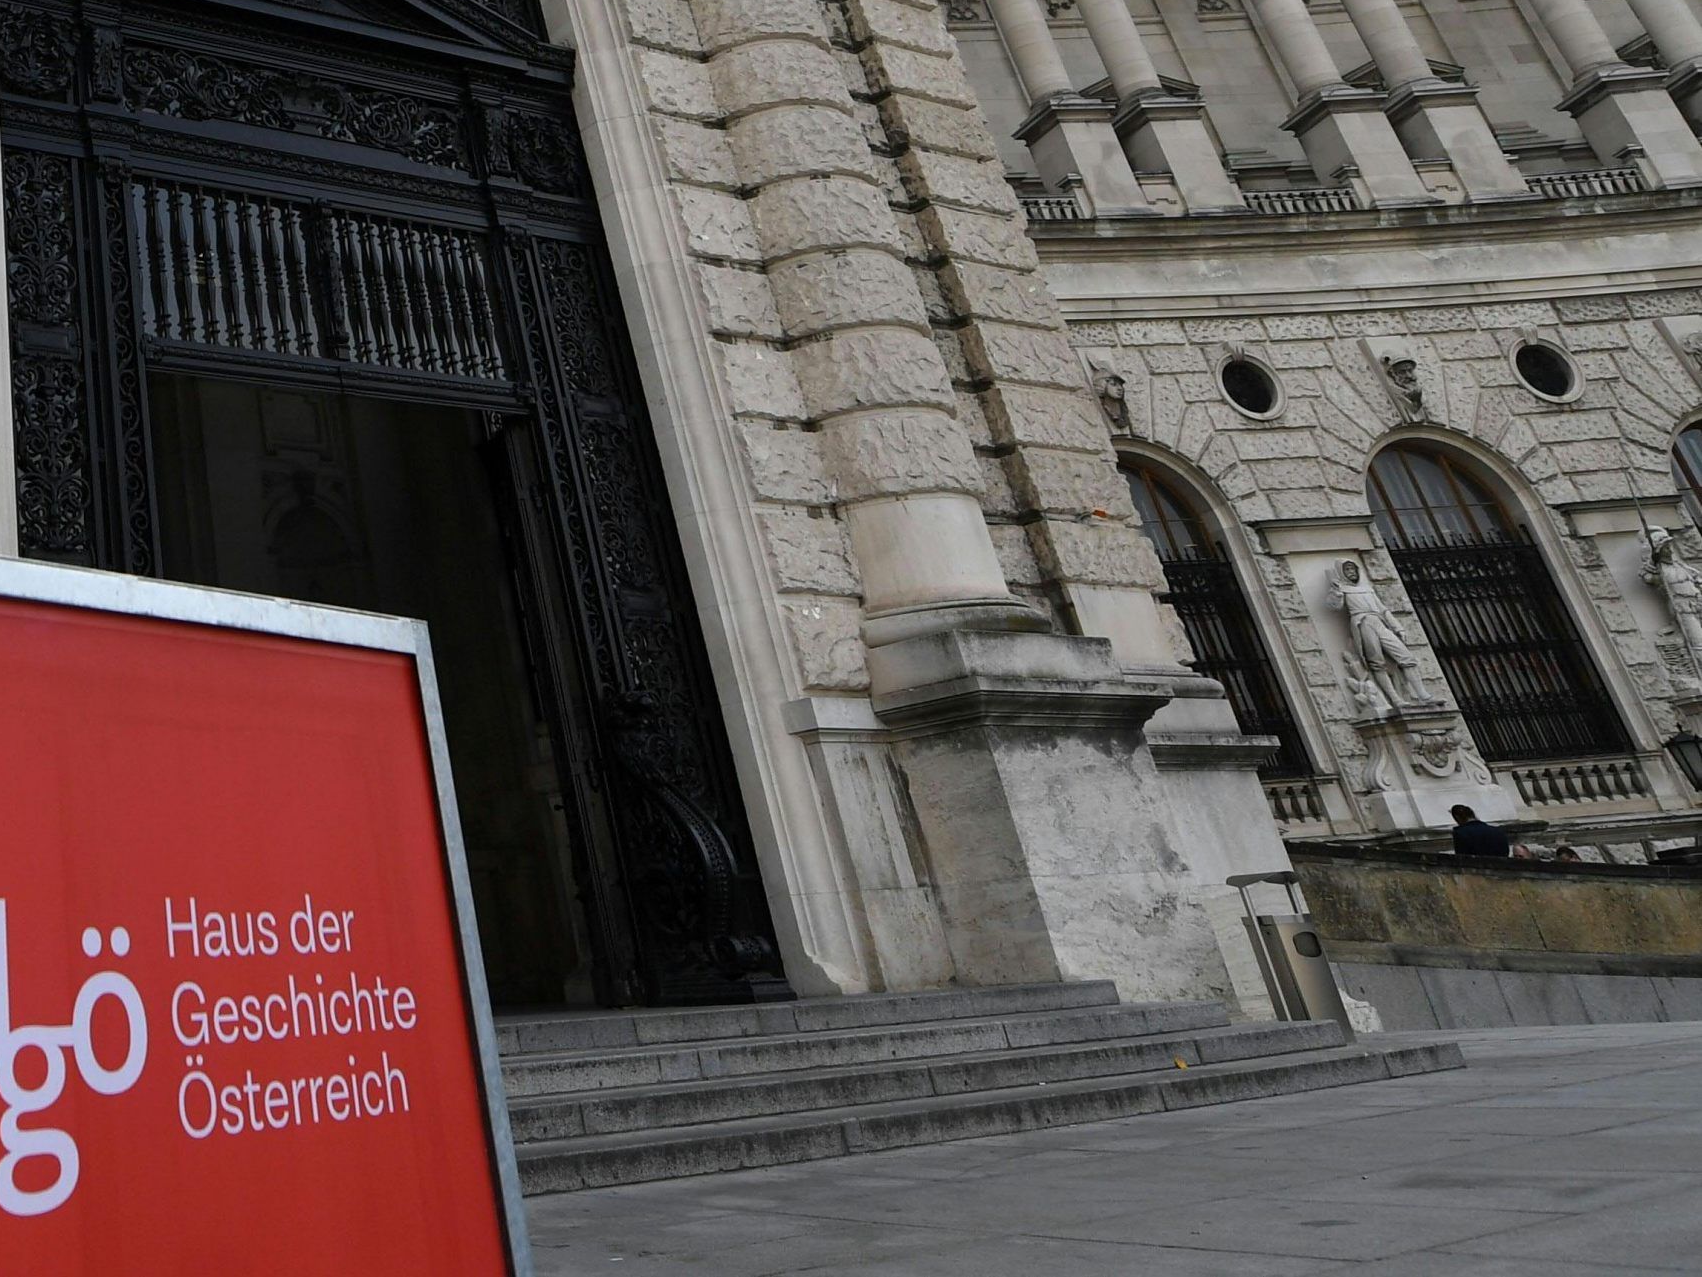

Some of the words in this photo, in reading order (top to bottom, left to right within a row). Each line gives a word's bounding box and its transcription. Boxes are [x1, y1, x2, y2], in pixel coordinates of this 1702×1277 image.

[165, 896, 280, 958] Haus
[290, 893, 355, 954] der
[171, 972, 417, 1047] Geschichte
[178, 1051, 410, 1139] Österreich
